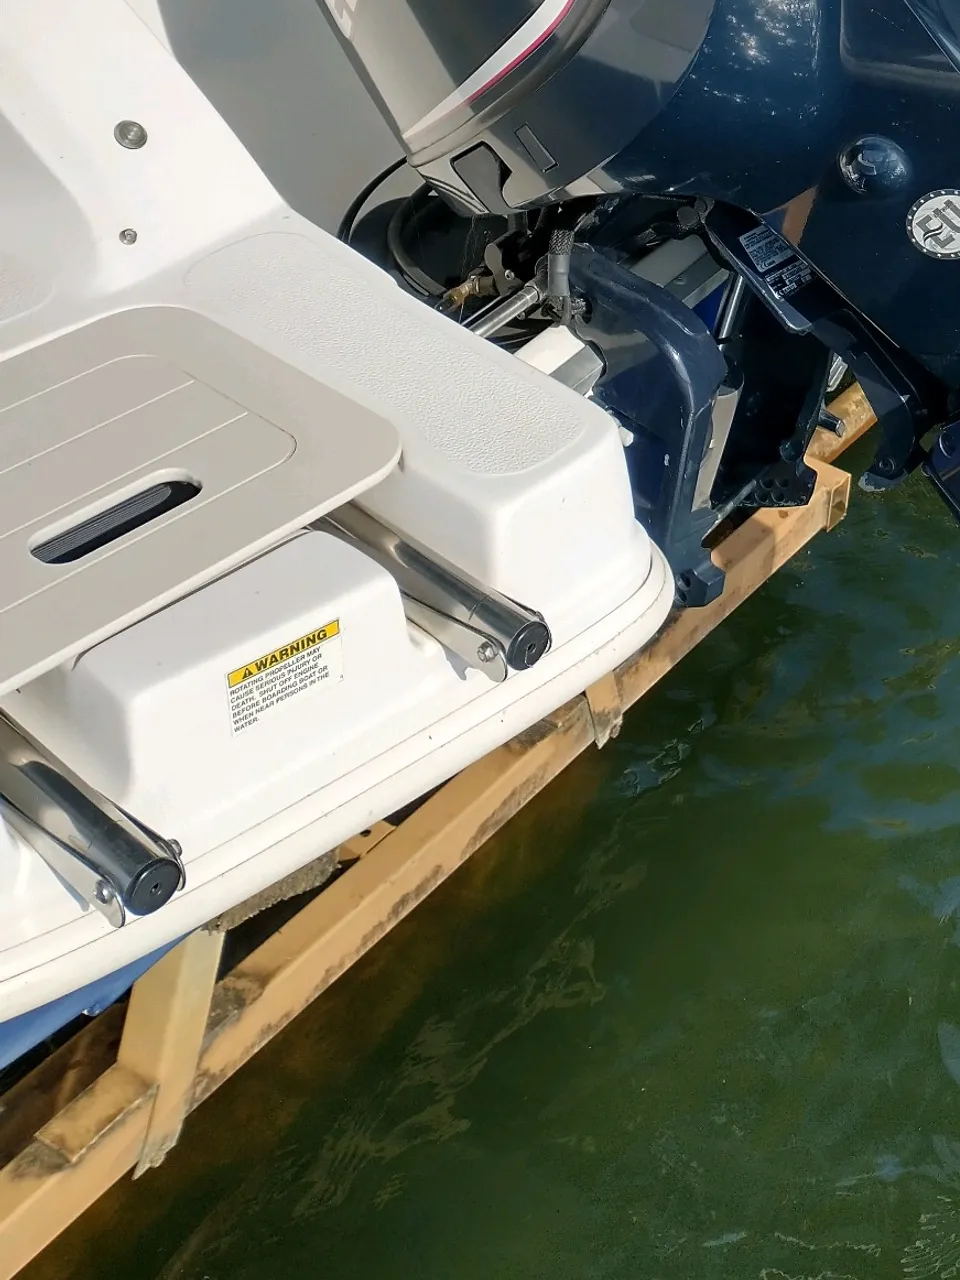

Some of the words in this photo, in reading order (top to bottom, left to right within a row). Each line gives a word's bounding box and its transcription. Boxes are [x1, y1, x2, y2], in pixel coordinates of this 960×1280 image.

[230, 675, 264, 696] ROTATING
[264, 654, 306, 678] PROPELLER
[306, 646, 321, 658] MAY
[254, 629, 327, 672] WARNING
[230, 687, 254, 704] CAUSE
[255, 672, 286, 691] SERIOUS
[287, 658, 311, 676] INJURY
[312, 653, 322, 662] OR
[232, 700, 260, 719] BEFORE
[262, 681, 298, 704] BOARDING
[298, 670, 317, 684] BOAT
[317, 664, 329, 675] OR
[232, 711, 255, 726] WHEN
[255, 700, 275, 714] NEAR
[276, 683, 308, 703] PERSONS
[308, 678, 317, 687] IN
[317, 670, 330, 682] THE
[258, 682, 278, 697] SHUT
[279, 675, 292, 687] OFF
[293, 661, 319, 679] ENGINE
